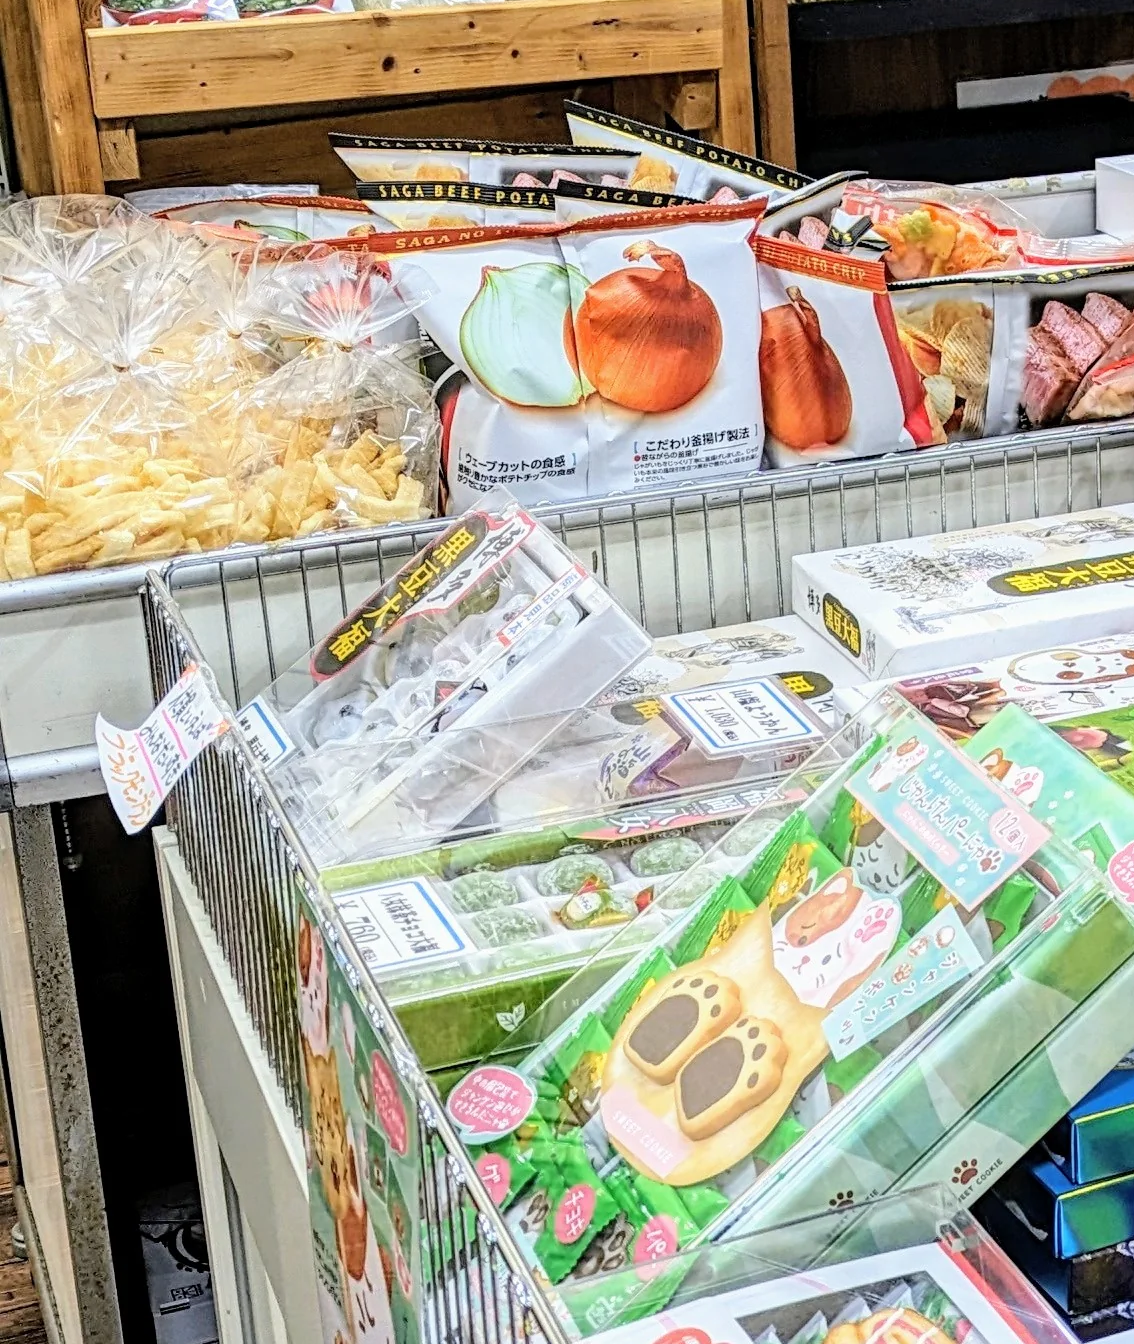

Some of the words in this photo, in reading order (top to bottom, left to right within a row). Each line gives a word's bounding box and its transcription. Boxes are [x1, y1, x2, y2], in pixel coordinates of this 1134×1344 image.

[354, 138, 405, 150] SAGA
[585, 110, 634, 134] SAGA
[642, 126, 686, 150] BEEF
[696, 144, 767, 178] POTATO
[380, 184, 424, 198] SAGA
[433, 185, 482, 200] BEEF
[495, 189, 551, 205] POTA
[584, 187, 633, 203] SAGA
[395, 232, 450, 249] SAGA
[326, 528, 477, 662] 黒豆大福
[824, 601, 861, 657] 黒豆大福
[961, 795, 990, 823] COOKIE
[612, 1110, 642, 1137] SWEET
[639, 1134, 674, 1164] COOKIE
[972, 1156, 1005, 1187] COOKIE
[564, 1190, 585, 1237] チョキ
